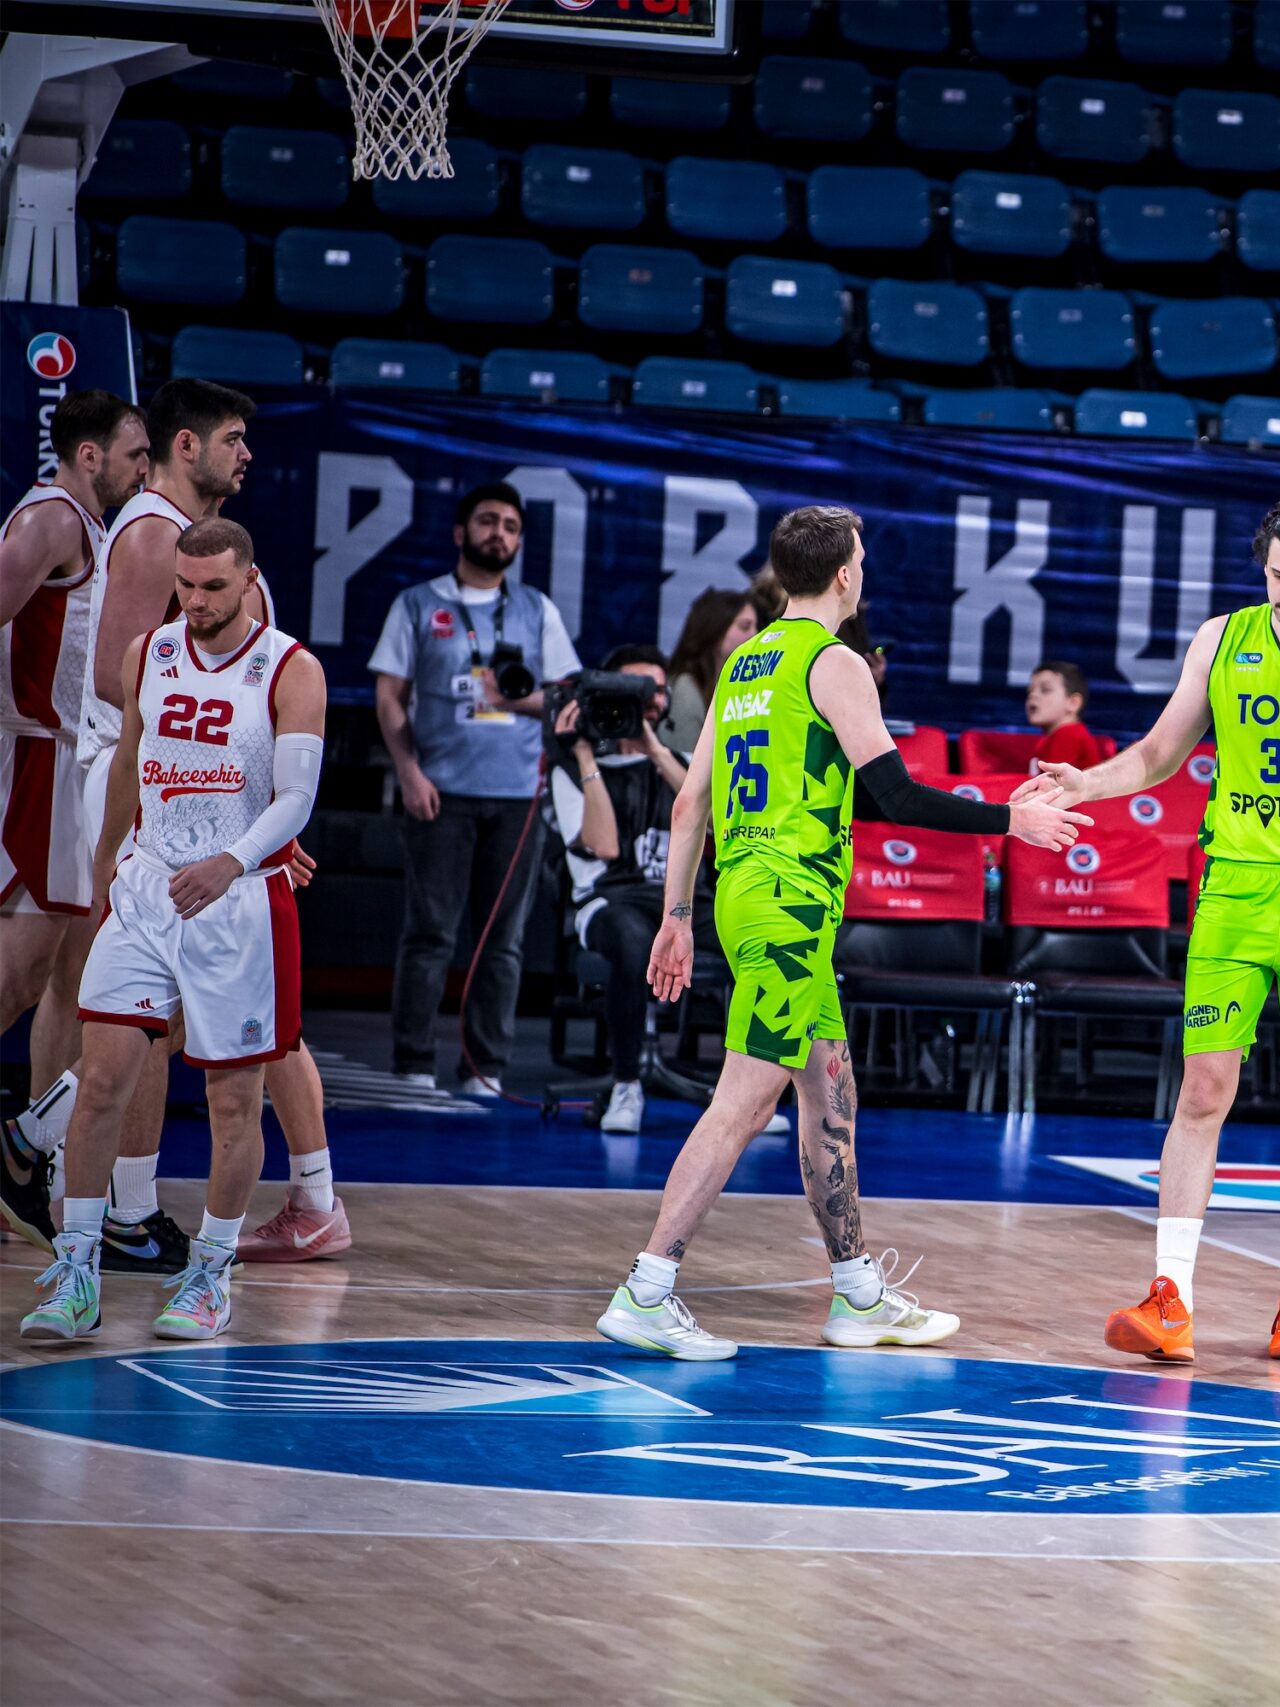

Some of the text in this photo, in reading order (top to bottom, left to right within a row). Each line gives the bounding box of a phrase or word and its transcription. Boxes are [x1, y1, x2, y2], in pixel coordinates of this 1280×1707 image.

[728, 650, 784, 683] BESSON
[158, 693, 234, 746] 22
[142, 760, 247, 787] Bahçeşehir
